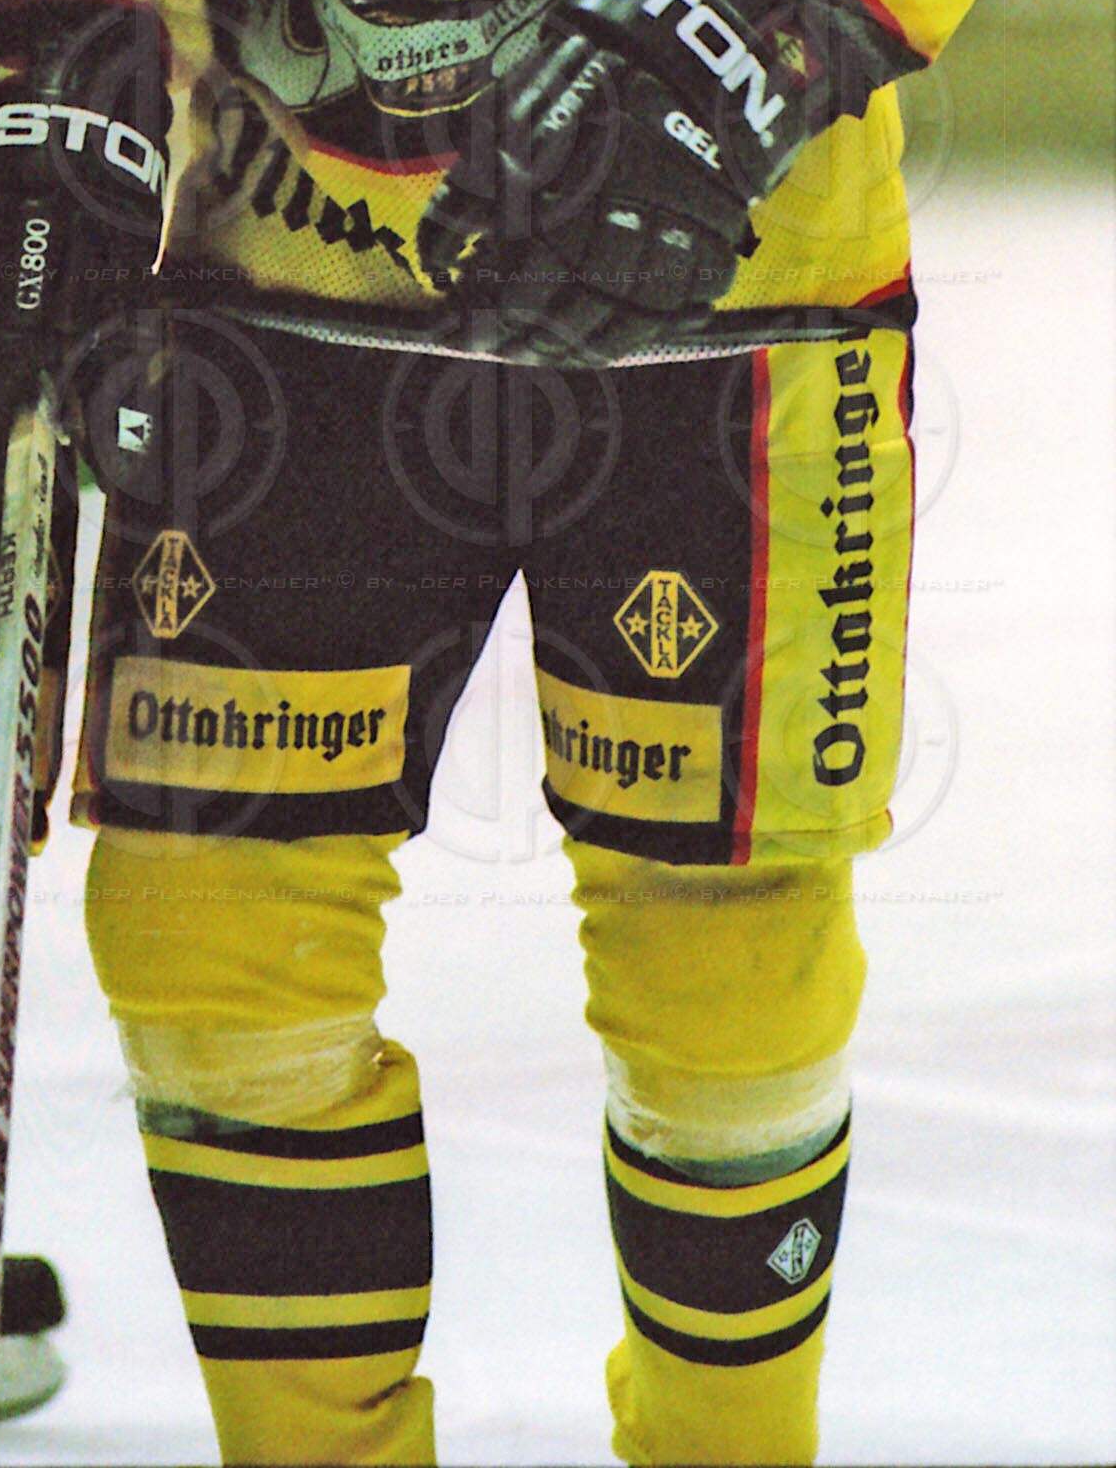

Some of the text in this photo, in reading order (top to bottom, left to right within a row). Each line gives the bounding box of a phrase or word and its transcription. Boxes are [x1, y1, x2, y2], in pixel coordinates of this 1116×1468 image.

[377, 37, 470, 74] others
[663, 109, 723, 174] GEL
[15, 217, 52, 310] GX800
[656, 580, 675, 674] TACKLA
[127, 685, 387, 760] Ottakringer
